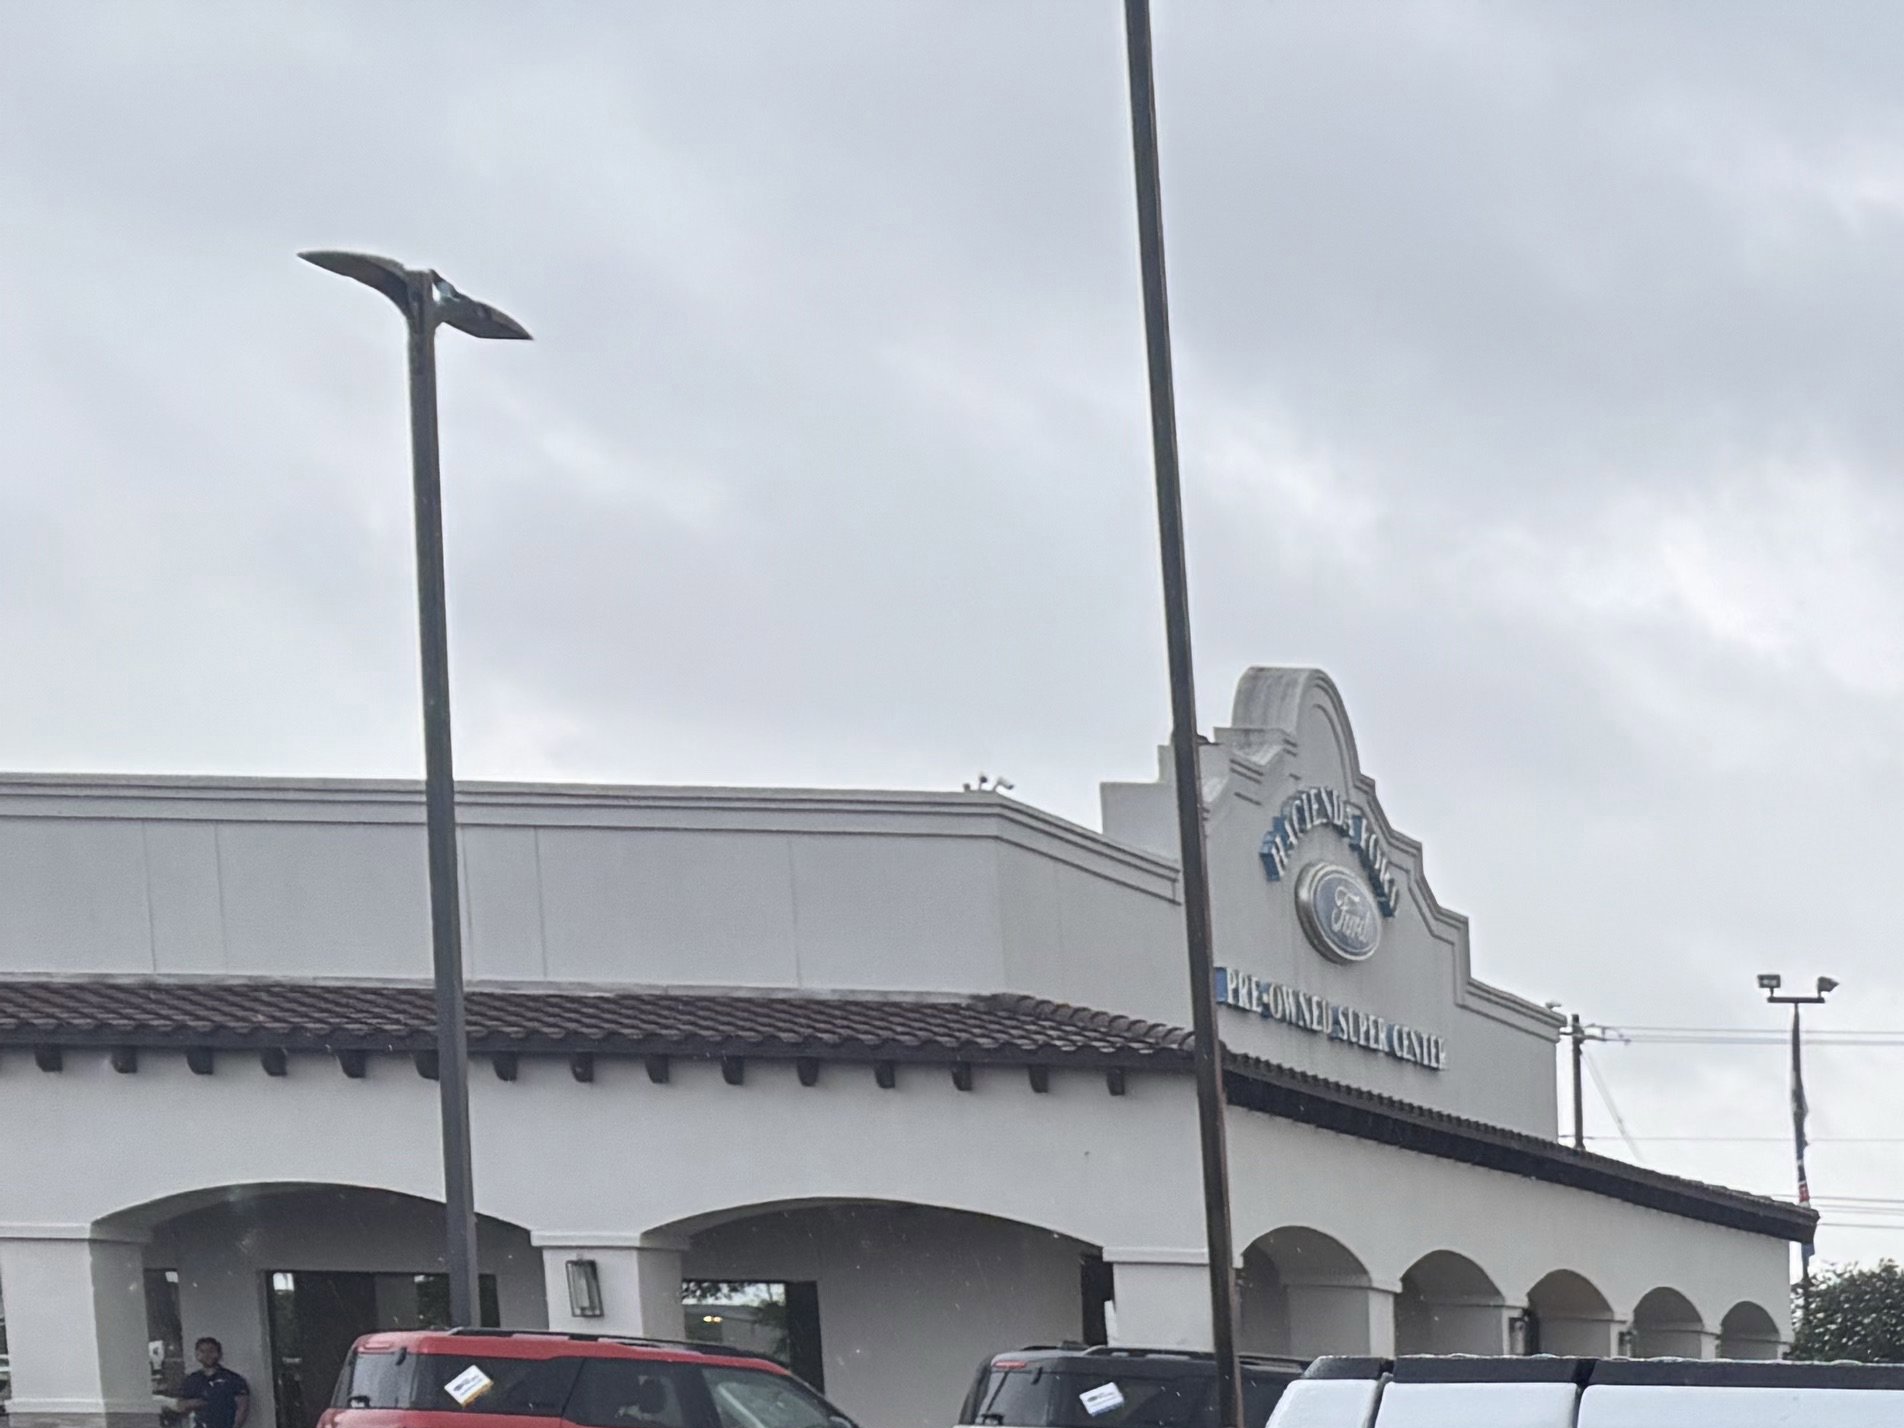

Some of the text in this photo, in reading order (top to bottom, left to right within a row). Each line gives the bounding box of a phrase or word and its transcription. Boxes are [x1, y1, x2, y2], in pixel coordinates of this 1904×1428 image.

[1331, 886, 1371, 943] Ford
[1218, 967, 1447, 1071] PRE-OWNED SUPER CENTER
